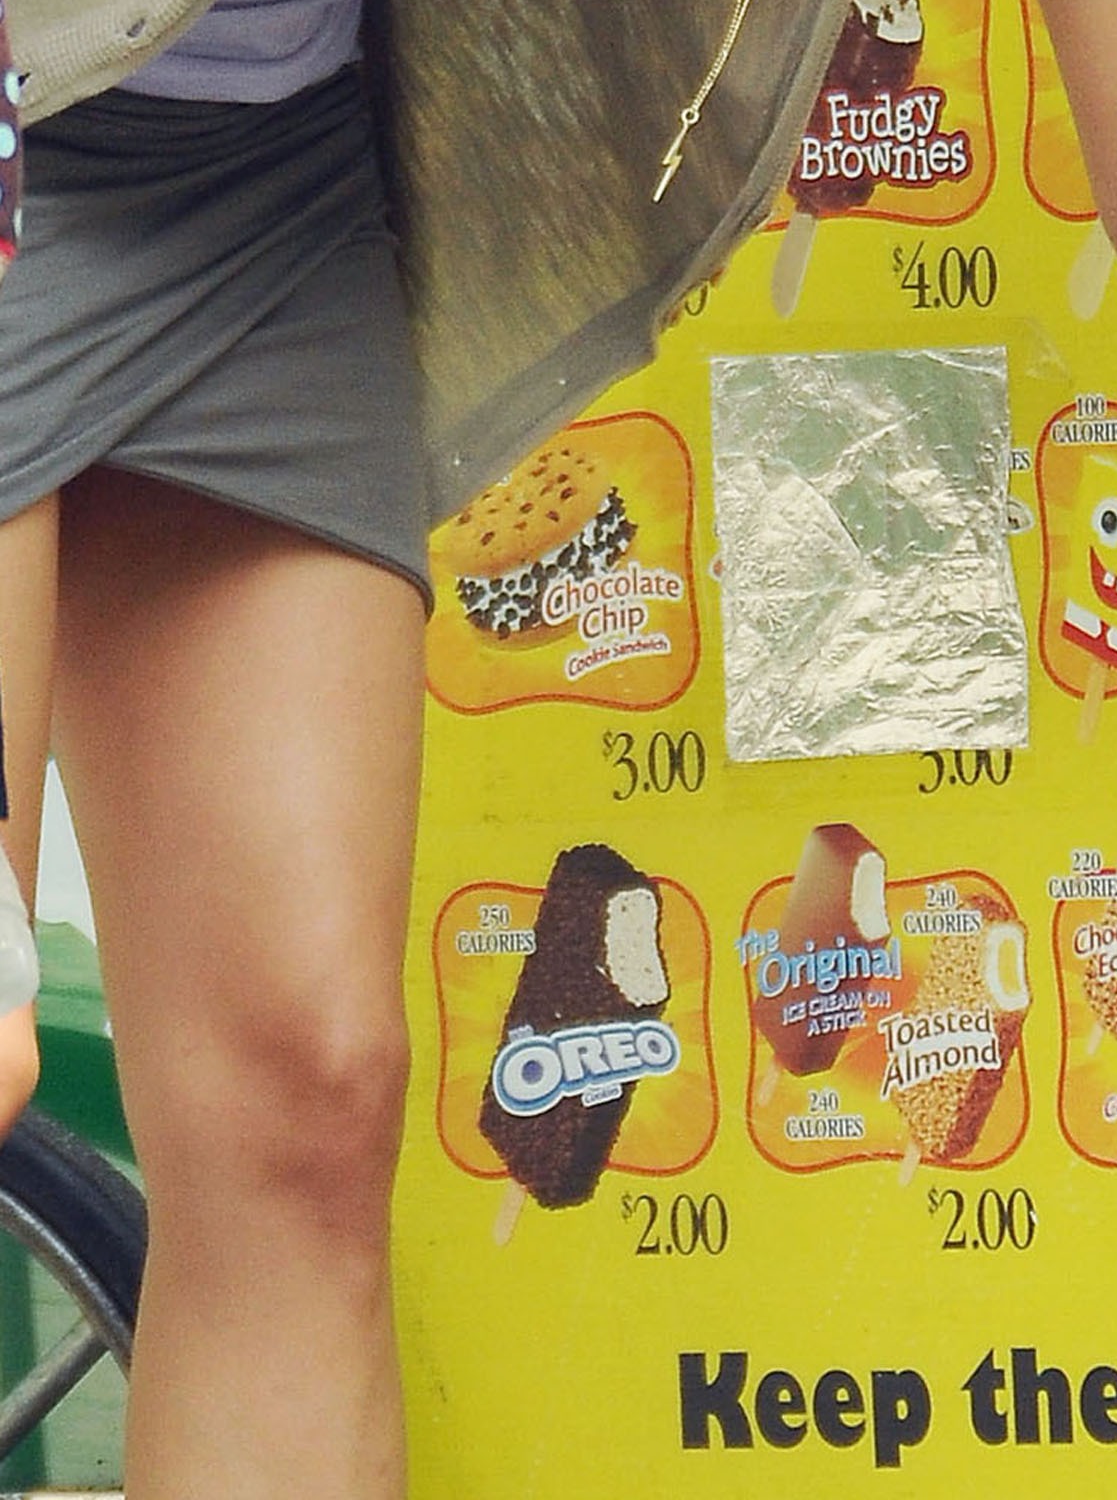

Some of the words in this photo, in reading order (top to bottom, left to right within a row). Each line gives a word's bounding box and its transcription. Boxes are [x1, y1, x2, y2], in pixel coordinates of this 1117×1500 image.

[827, 93, 942, 142] Fudgy
[800, 137, 967, 181] Brownies
[893, 241, 998, 311] $4.00
[1076, 397, 1105, 417] 100
[546, 570, 682, 622] Chocolate
[582, 604, 646, 640] Chip
[568, 647, 611, 677] Cookie
[603, 729, 705, 801] $3.00
[1072, 852, 1101, 872] 220
[480, 906, 510, 928] 250
[926, 886, 957, 908] 240
[457, 933, 536, 954] CALORIES
[903, 912, 982, 934] CALORIES
[757, 937, 902, 998] Original
[782, 1001, 807, 1027] ICE
[809, 991, 865, 1017] CREAM
[867, 990, 891, 1008] ON
[880, 1009, 991, 1051] Toasted
[500, 1027, 675, 1106] OREO
[882, 1039, 999, 1098] Almond
[809, 1092, 839, 1113] 240
[786, 1117, 864, 1138] CALORIES
[622, 1191, 728, 1256] $2.00
[928, 1187, 1037, 1251] $2.00
[678, 1351, 932, 1469] Keep
